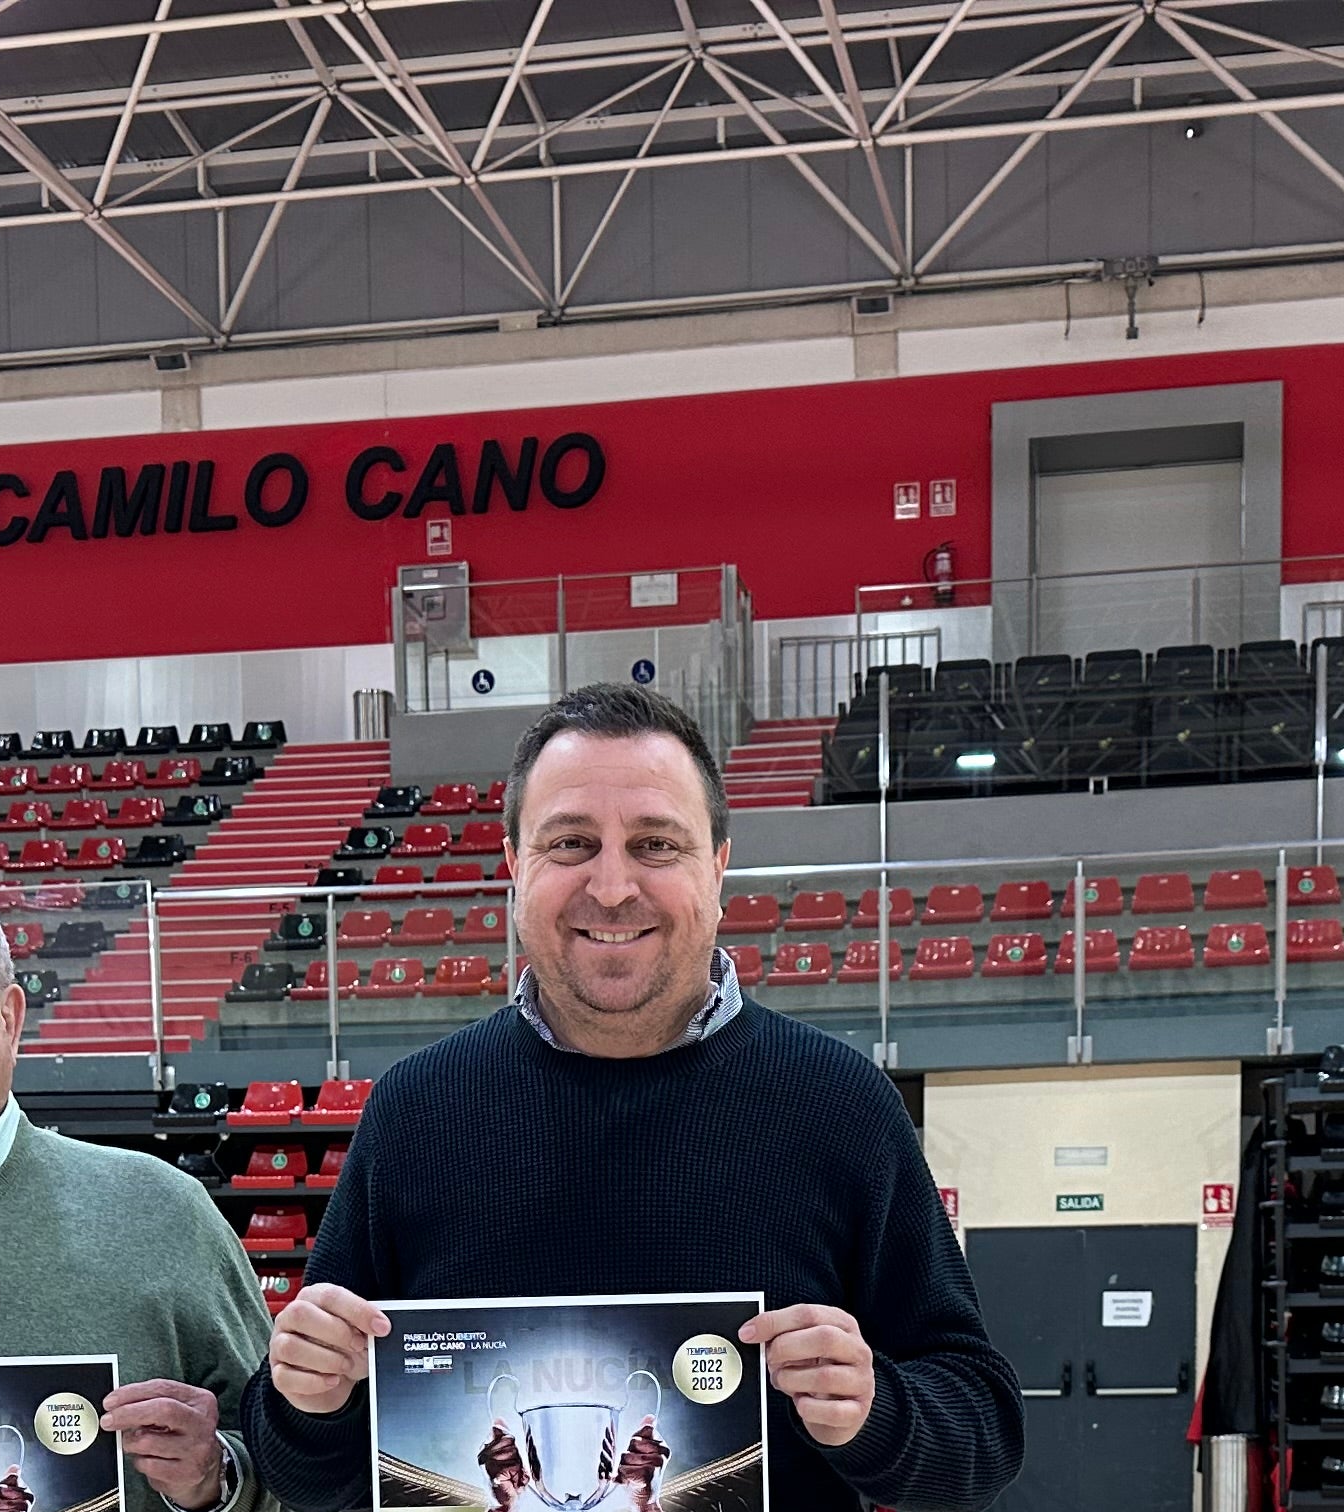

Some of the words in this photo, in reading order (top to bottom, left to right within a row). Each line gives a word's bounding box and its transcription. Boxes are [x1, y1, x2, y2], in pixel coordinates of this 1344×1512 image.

[344, 431, 606, 522] CANO
[1059, 1196, 1100, 1209] SALIDA
[470, 1341, 481, 1350] LA
[692, 1359, 723, 1373] 2022
[692, 1376, 723, 1390] 2023
[52, 1414, 81, 1427] 2022
[53, 1430, 81, 1443] 2023
